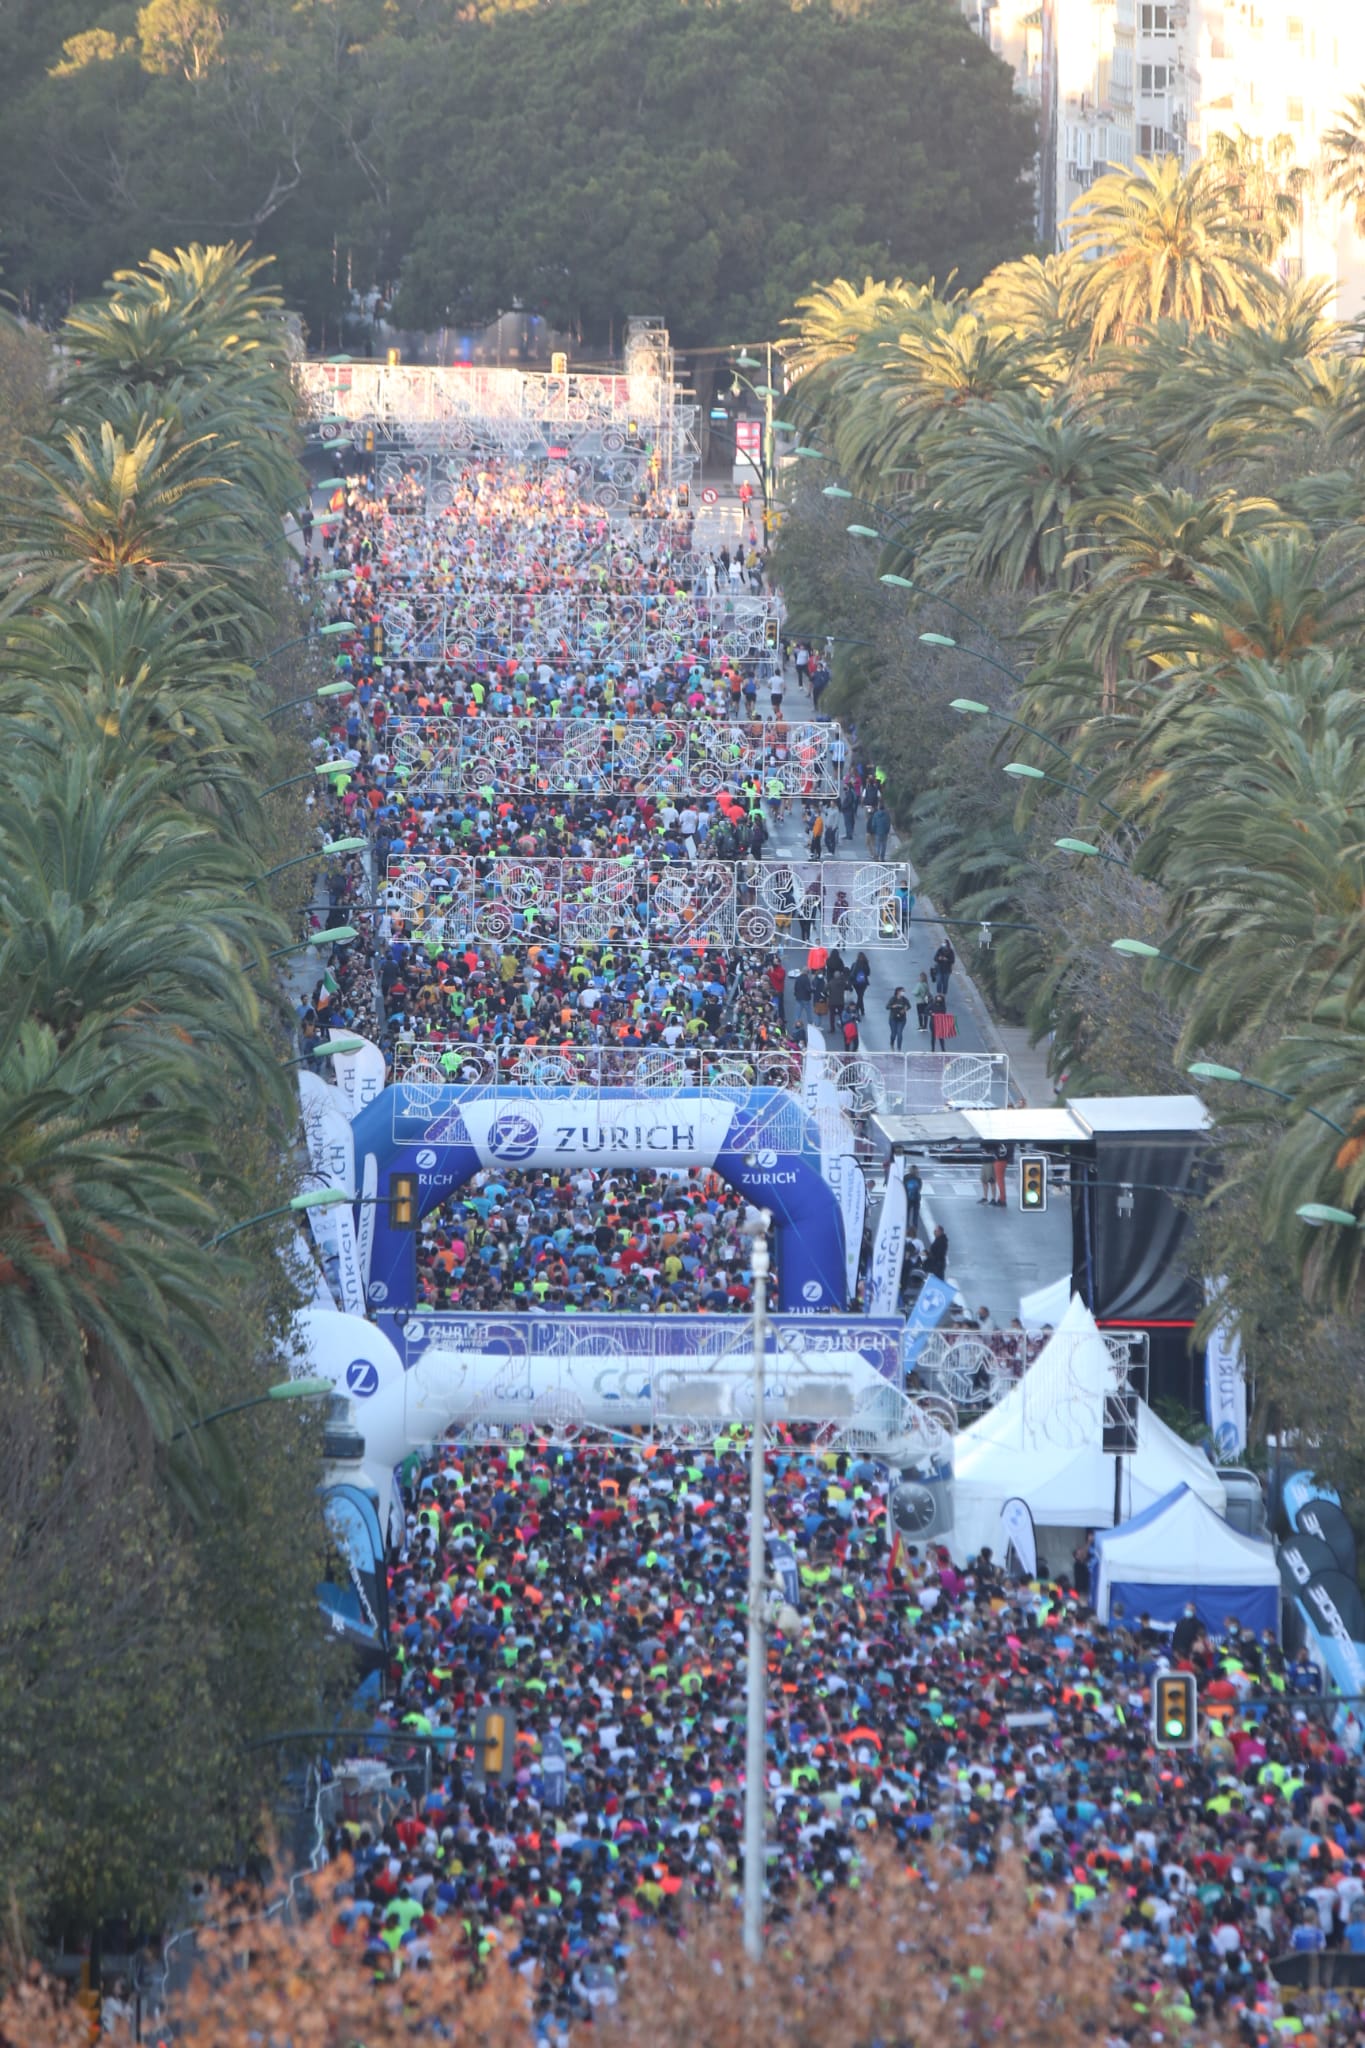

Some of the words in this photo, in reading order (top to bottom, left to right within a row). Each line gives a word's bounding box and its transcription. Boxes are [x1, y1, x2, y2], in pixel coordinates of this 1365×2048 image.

[554, 1125, 695, 1152] ZURICH
[419, 1173, 453, 1185] RICH
[742, 1172, 797, 1185] ZURICH
[815, 1335, 886, 1352] ZURICH
